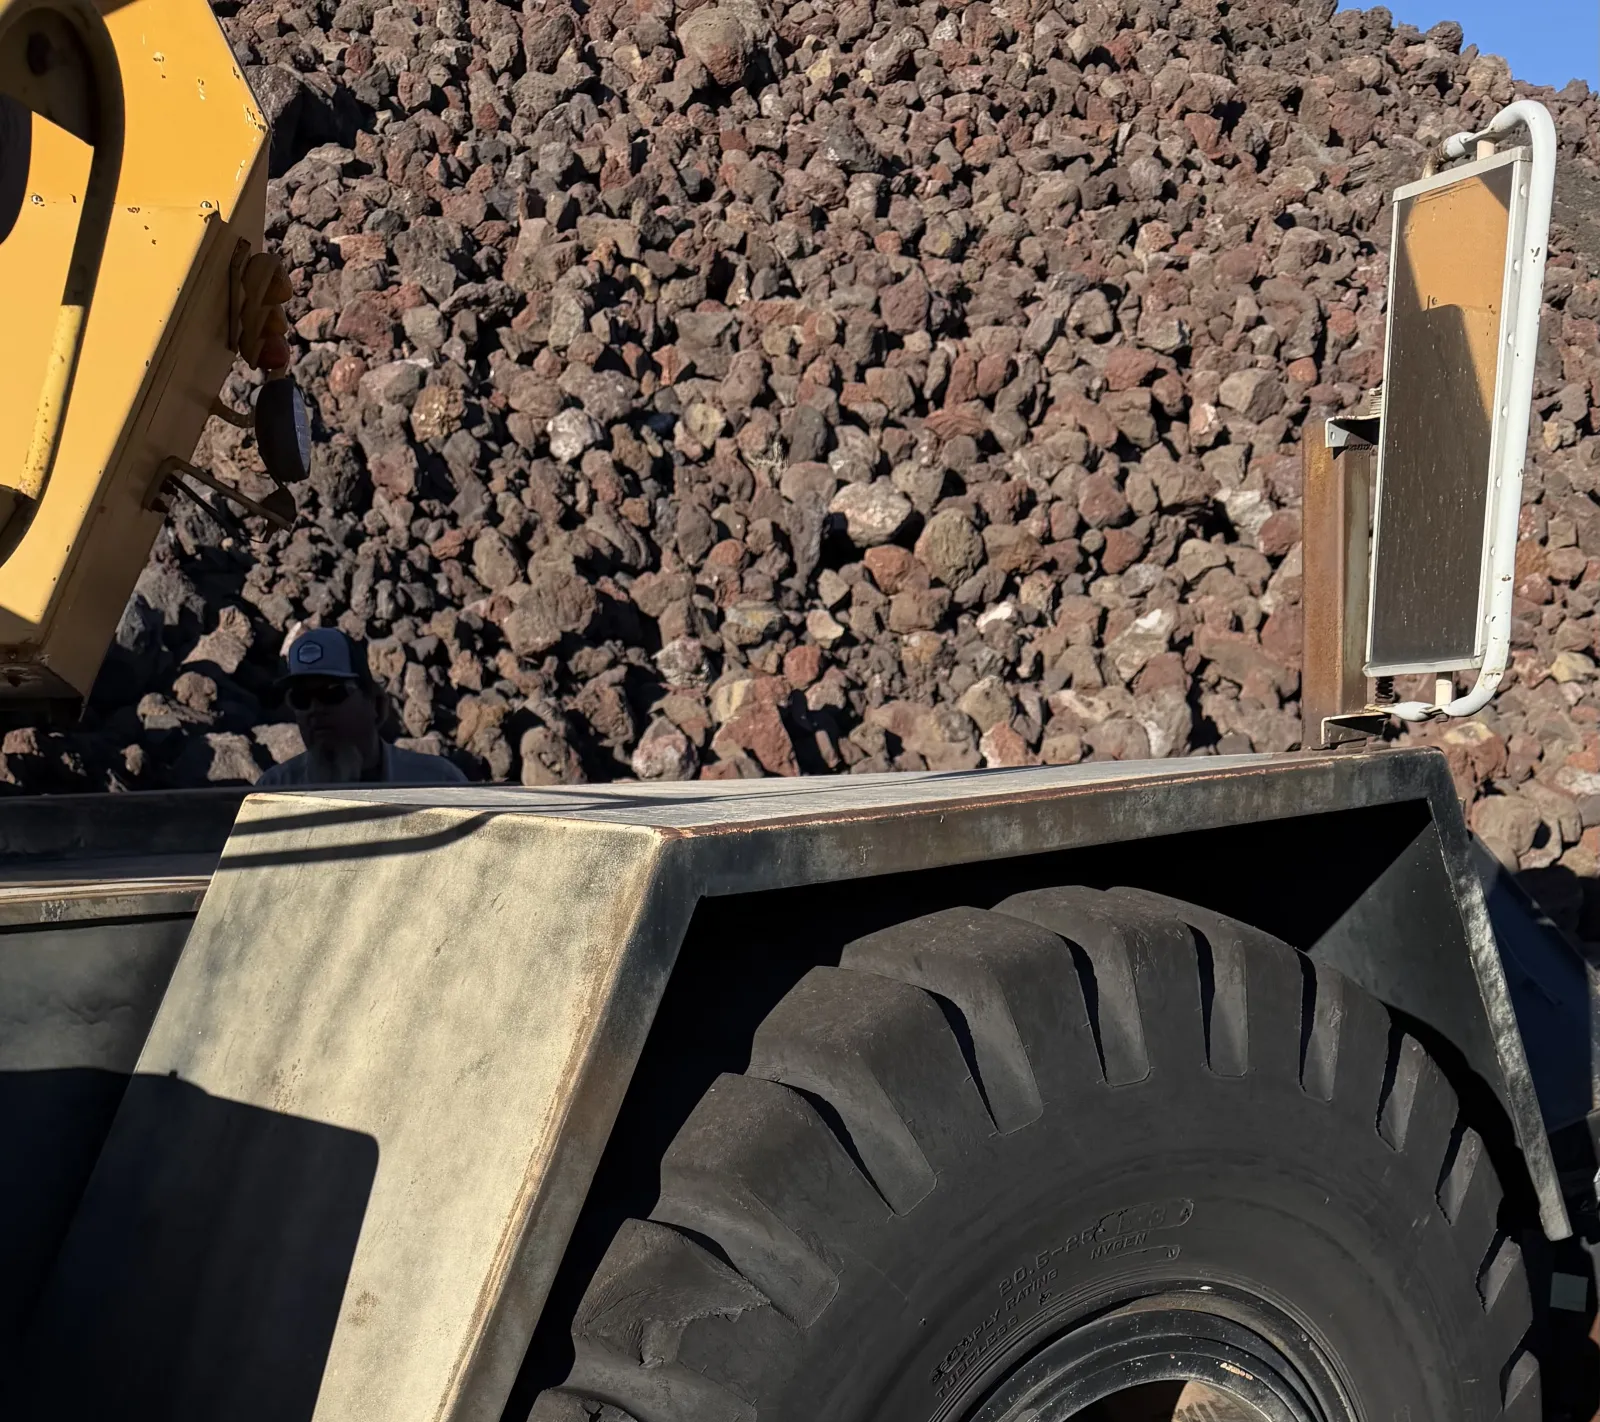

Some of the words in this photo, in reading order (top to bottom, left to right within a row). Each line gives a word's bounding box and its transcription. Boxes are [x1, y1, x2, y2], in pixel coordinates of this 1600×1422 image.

[972, 1308, 1001, 1341] PLY
[1005, 1268, 1059, 1311] RATING
[935, 1314, 1020, 1398] TUBELESS
